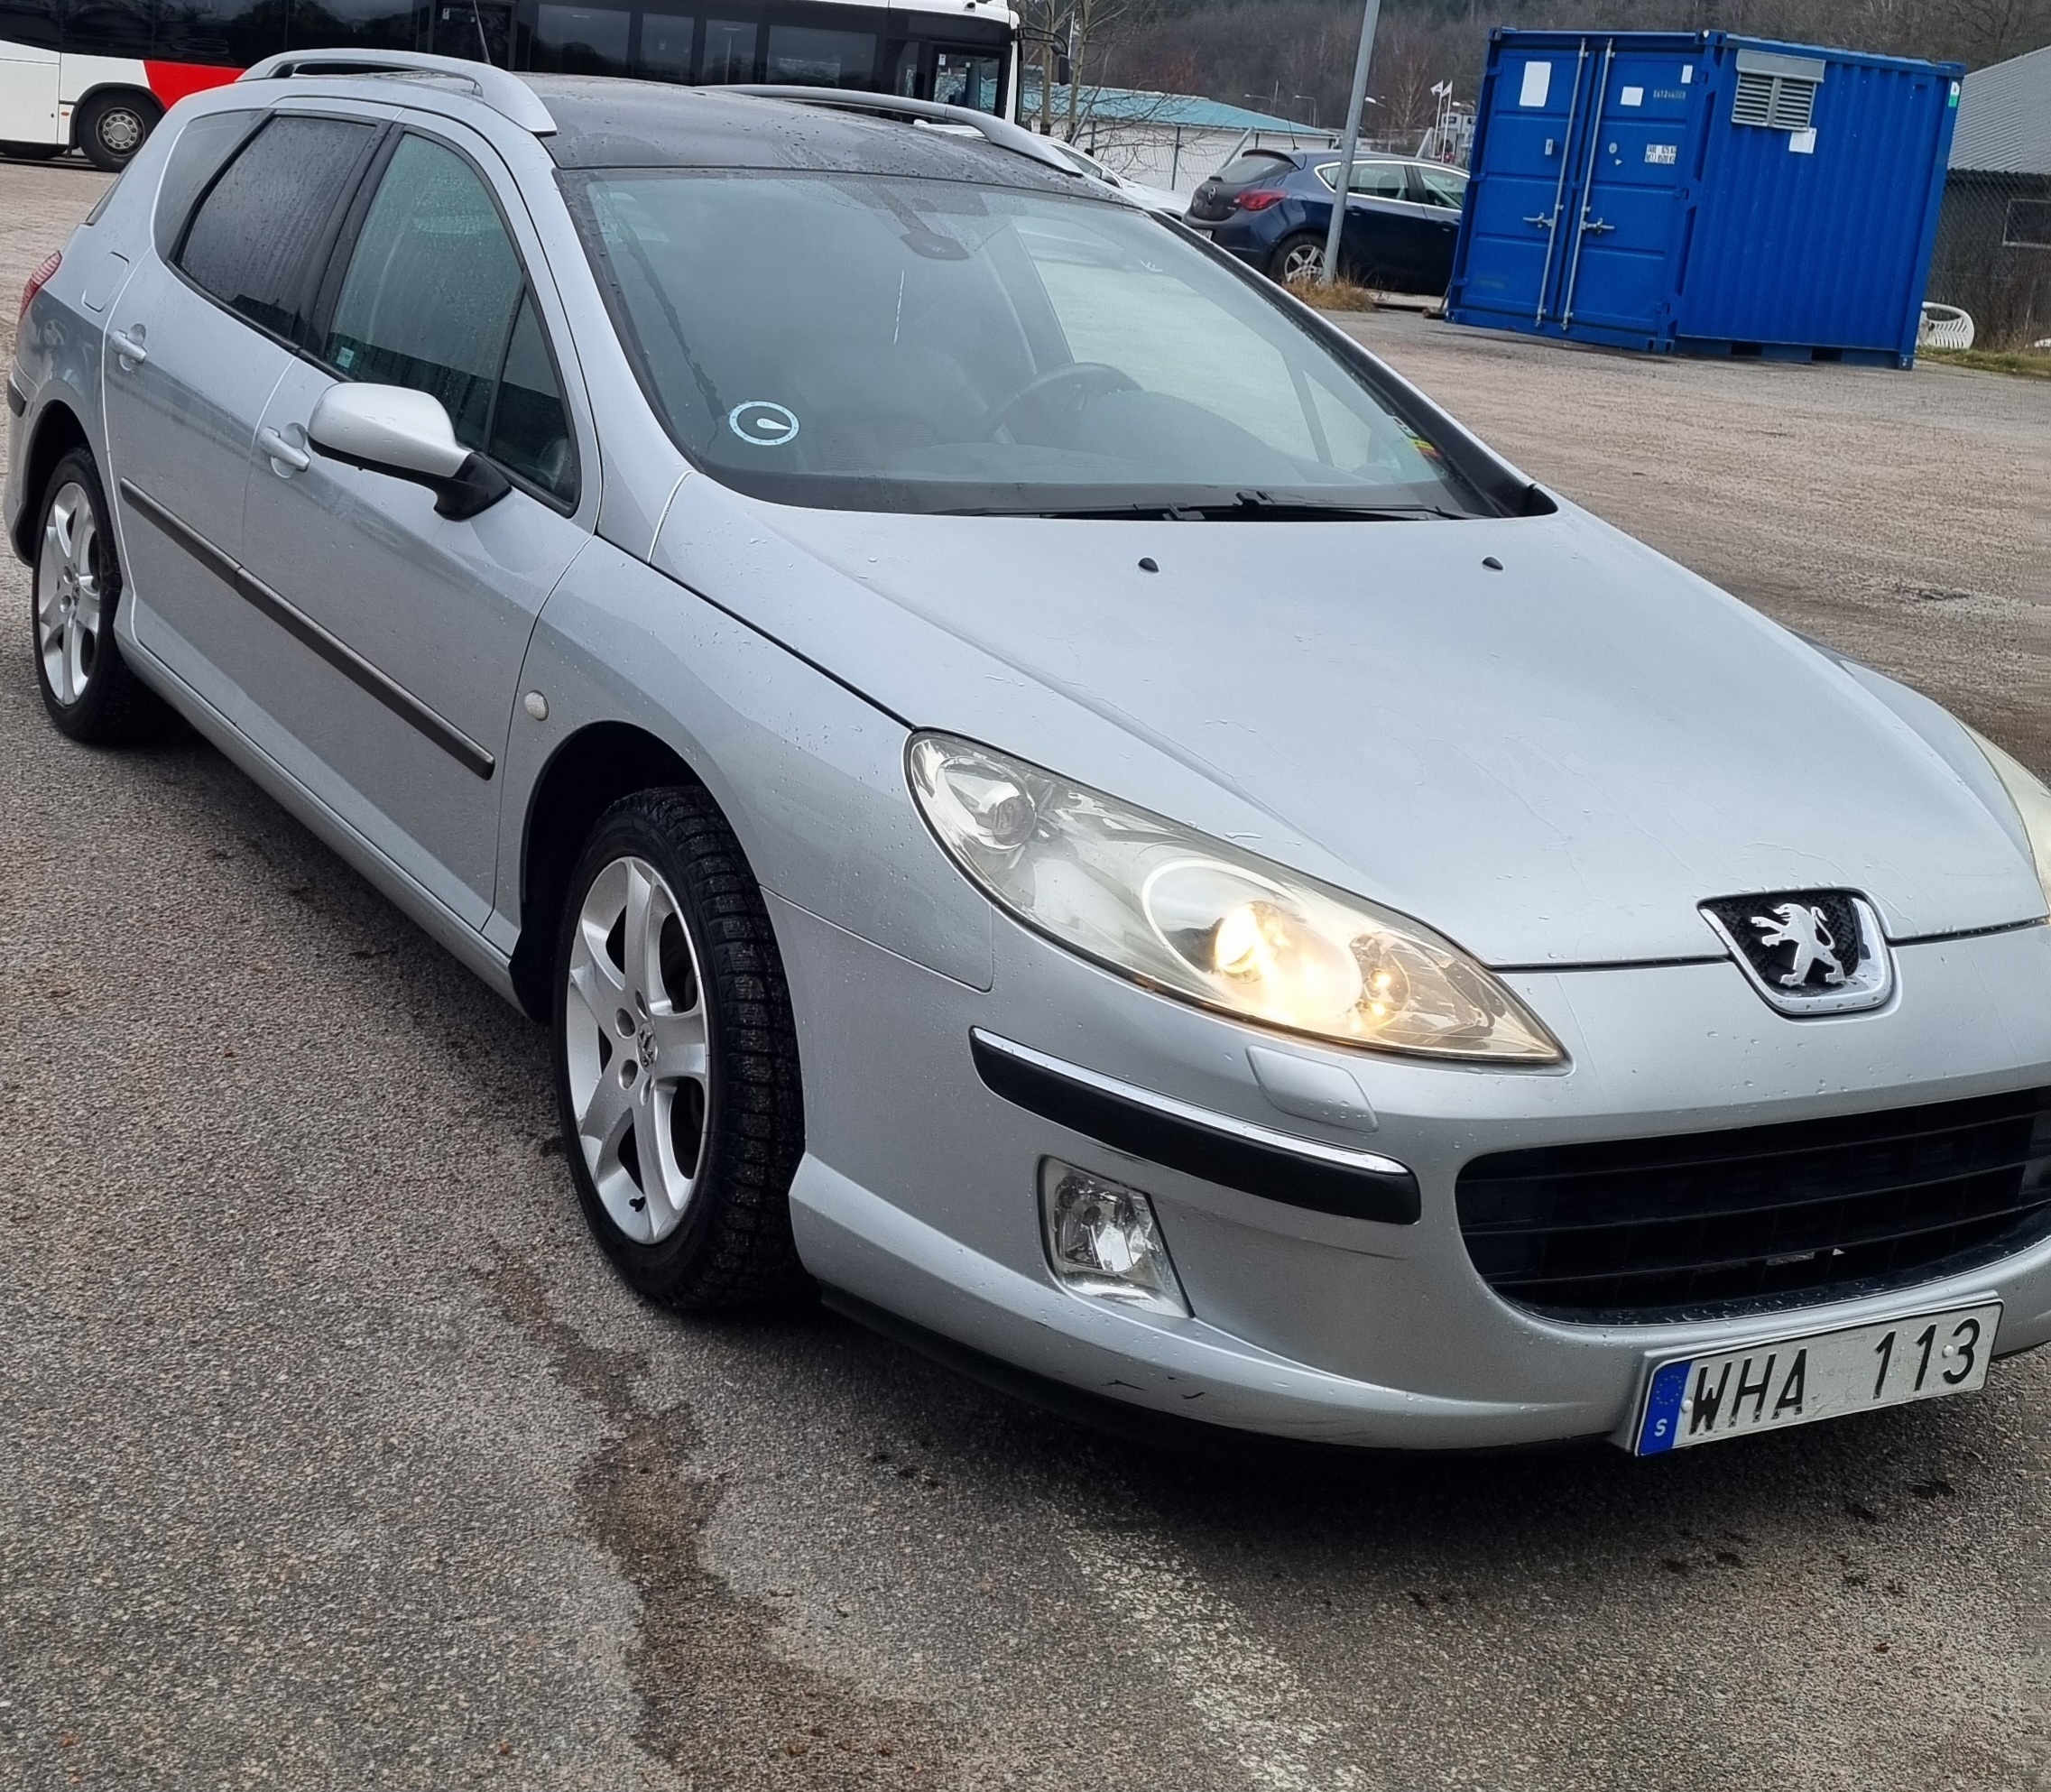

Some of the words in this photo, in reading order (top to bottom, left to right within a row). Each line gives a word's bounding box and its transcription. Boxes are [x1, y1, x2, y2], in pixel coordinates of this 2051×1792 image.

[1689, 1348, 1807, 1436] WHA
[1874, 1318, 1981, 1399] 113
[1654, 1418, 1668, 1437] S
